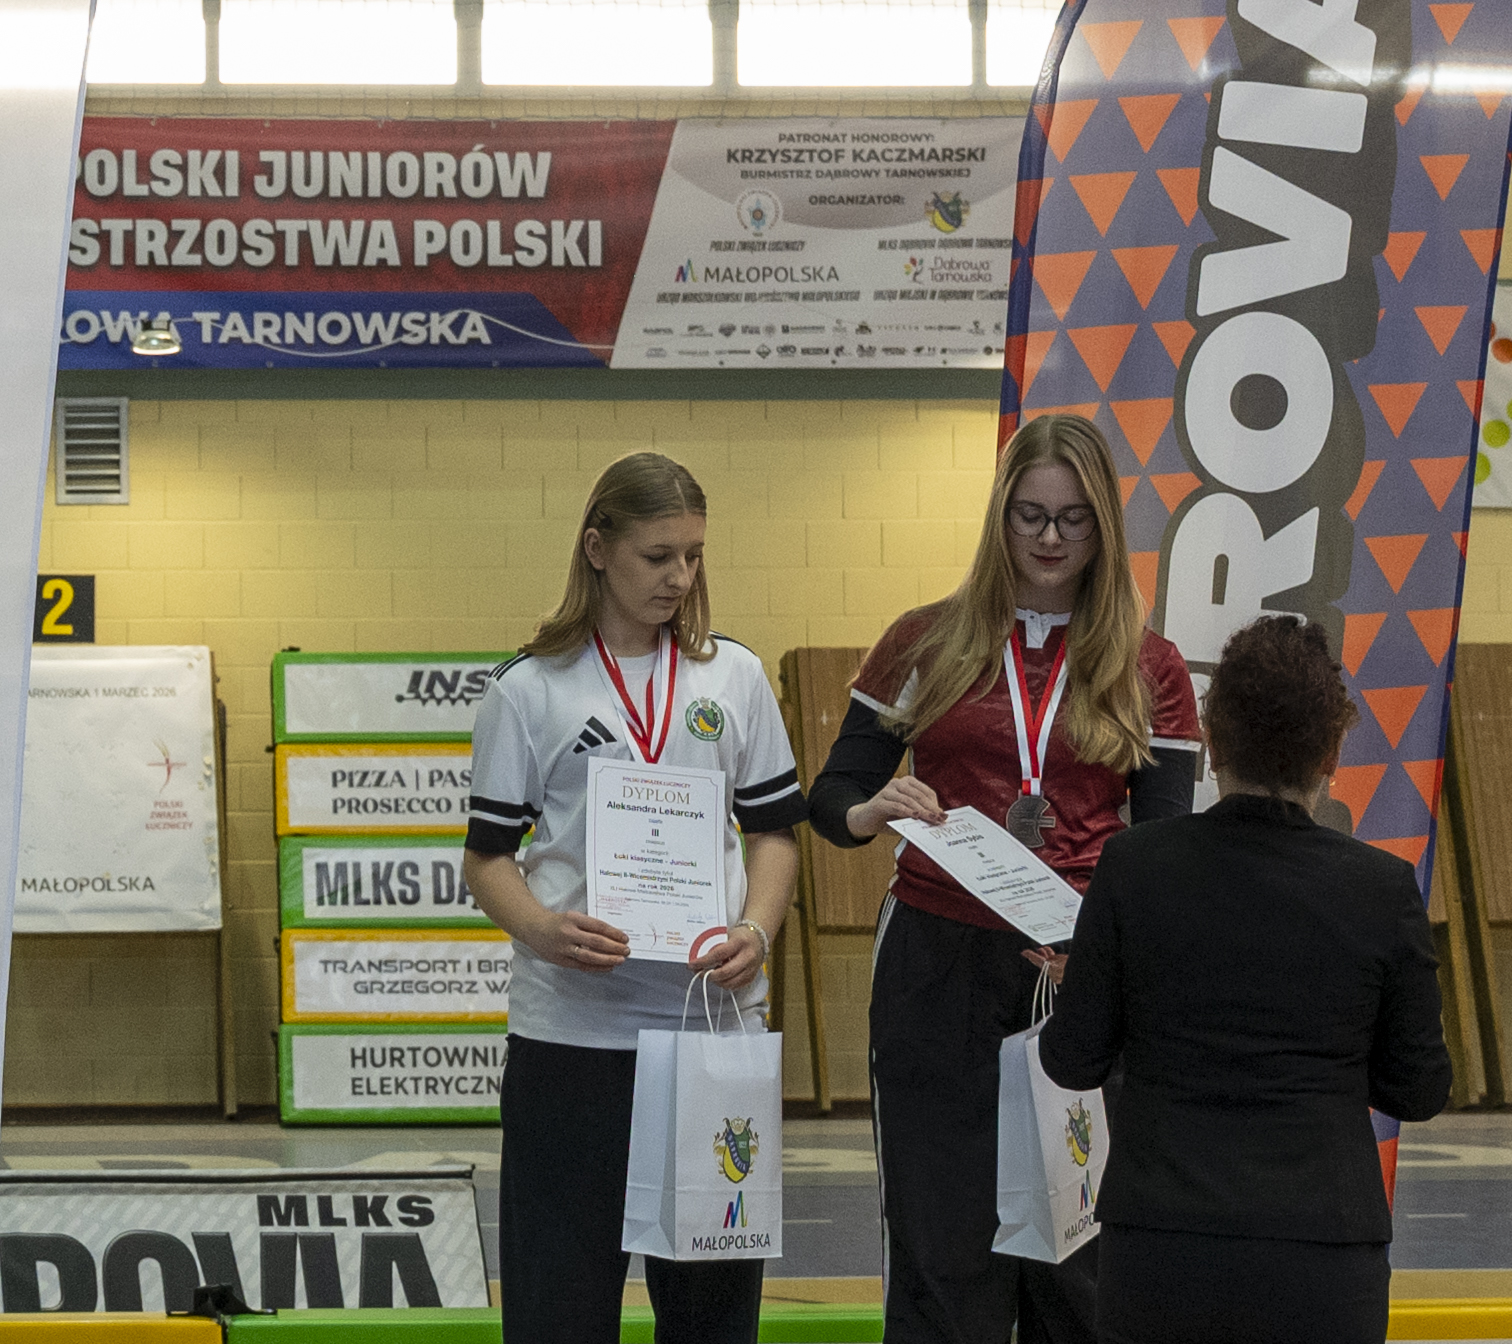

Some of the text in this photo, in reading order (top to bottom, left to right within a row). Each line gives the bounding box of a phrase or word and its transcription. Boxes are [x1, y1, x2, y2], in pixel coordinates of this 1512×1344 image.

[778, 132, 936, 144] PATRONAT HONOROWY:
[726, 147, 987, 164] KRZYSZTOF KACZMARSKI
[60, 141, 553, 199] OLSKI JUNIORÓW
[740, 168, 971, 181] BURMISTRZ DĄBROWY TARNOWSKIEJ
[808, 194, 906, 206] ORGANIZATOR:
[424, 218, 603, 268] POLSKI
[704, 265, 840, 284] MAŁOPOLSKA
[194, 311, 492, 346] TARNOWSKA
[41, 578, 75, 636] 2
[102, 686, 177, 699] MARZEC 2026
[331, 768, 406, 790] PIZZA
[622, 785, 691, 805] DYPLOM
[331, 796, 453, 816] PROSECCO
[606, 800, 705, 820] Aleksandra Lekarczyk
[21, 876, 156, 893] MAŁOPOLSKA
[315, 860, 421, 907] MLKS
[319, 959, 461, 975] TRANSPORT
[353, 980, 480, 995] GRZEGORZ
[350, 1075, 501, 1097] ELEKTRYCZN
[257, 1194, 437, 1228] MLKS
[691, 1232, 772, 1253] MAŁOPOLSKA
